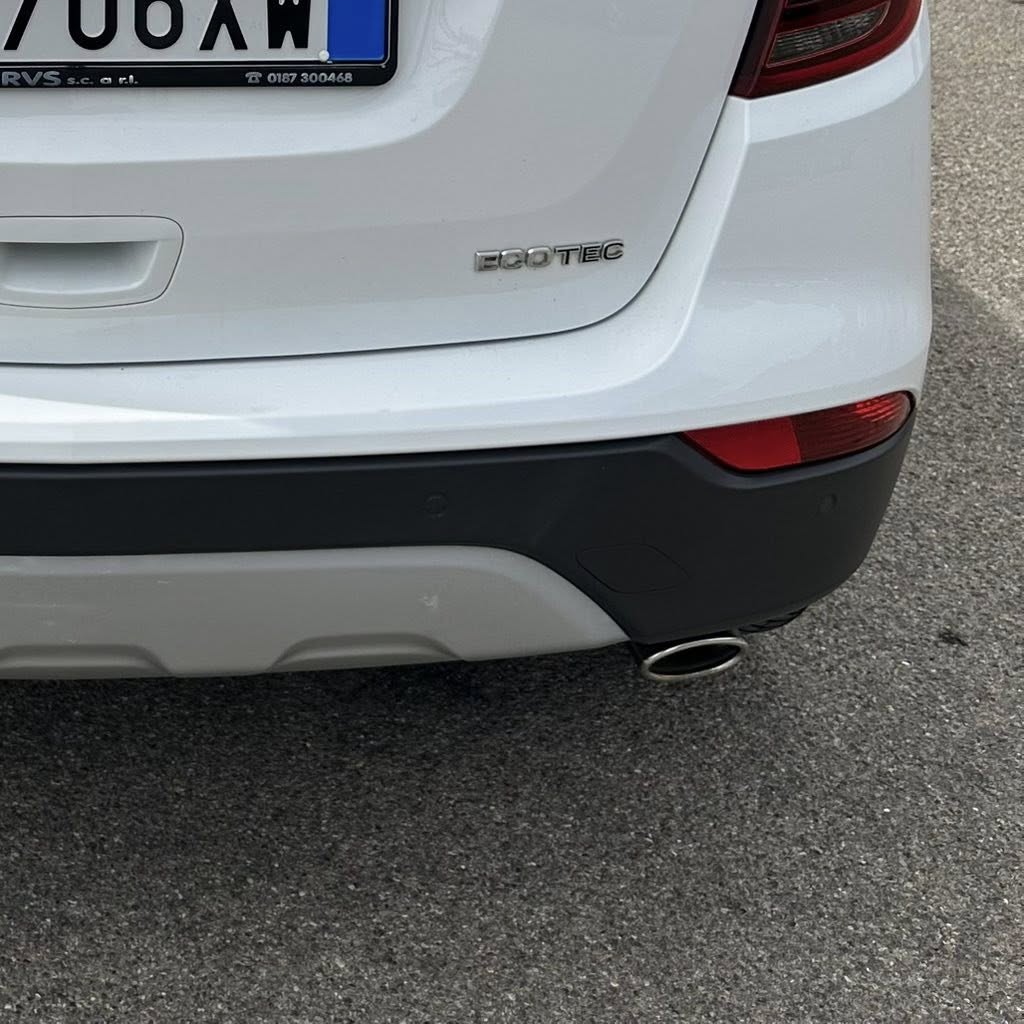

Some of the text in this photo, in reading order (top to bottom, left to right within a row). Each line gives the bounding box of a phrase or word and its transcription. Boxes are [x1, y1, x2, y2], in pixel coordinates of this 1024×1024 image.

[1, 70, 61, 87] RVS
[267, 72, 353, 84] 0187 300468
[474, 239, 625, 272] ECOTEC
